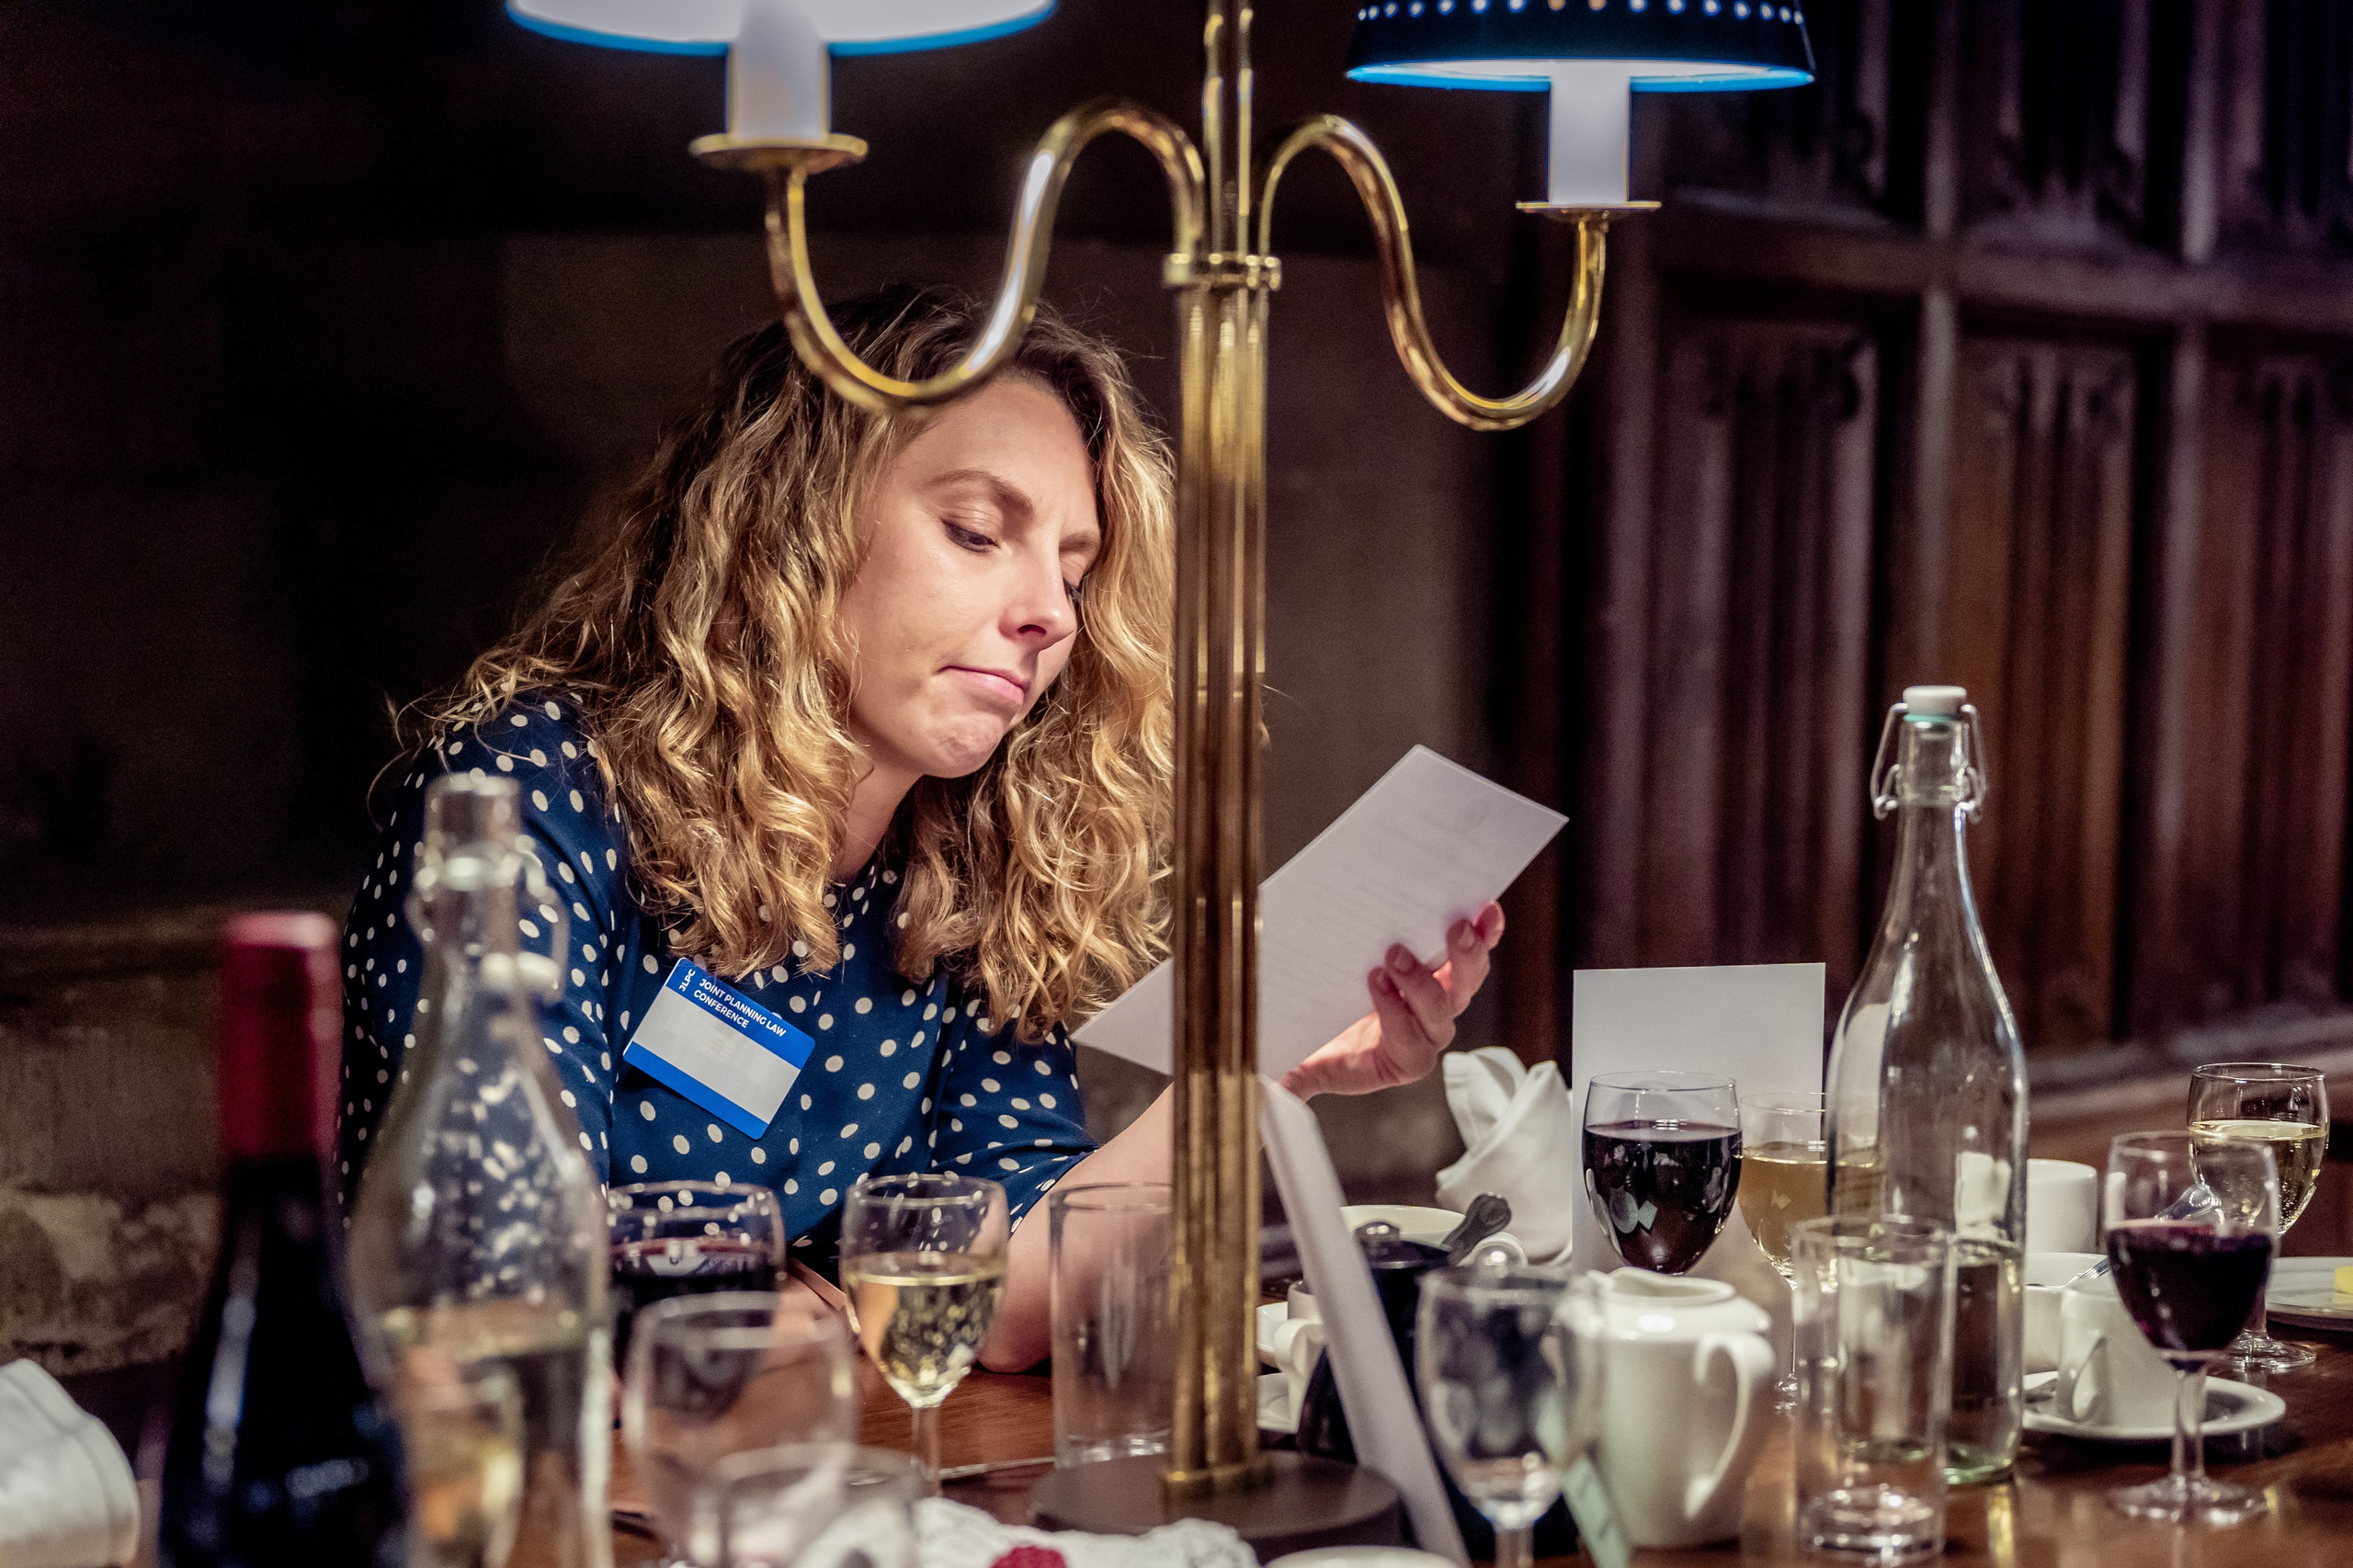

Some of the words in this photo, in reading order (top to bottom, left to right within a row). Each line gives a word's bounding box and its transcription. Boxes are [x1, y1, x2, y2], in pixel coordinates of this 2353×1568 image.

[678, 969, 696, 992] JLPC
[693, 989, 750, 1028] CONFERENCE
[699, 979, 726, 998] JOINT
[724, 994, 767, 1026] PLANNING
[766, 1020, 787, 1037] LAW
